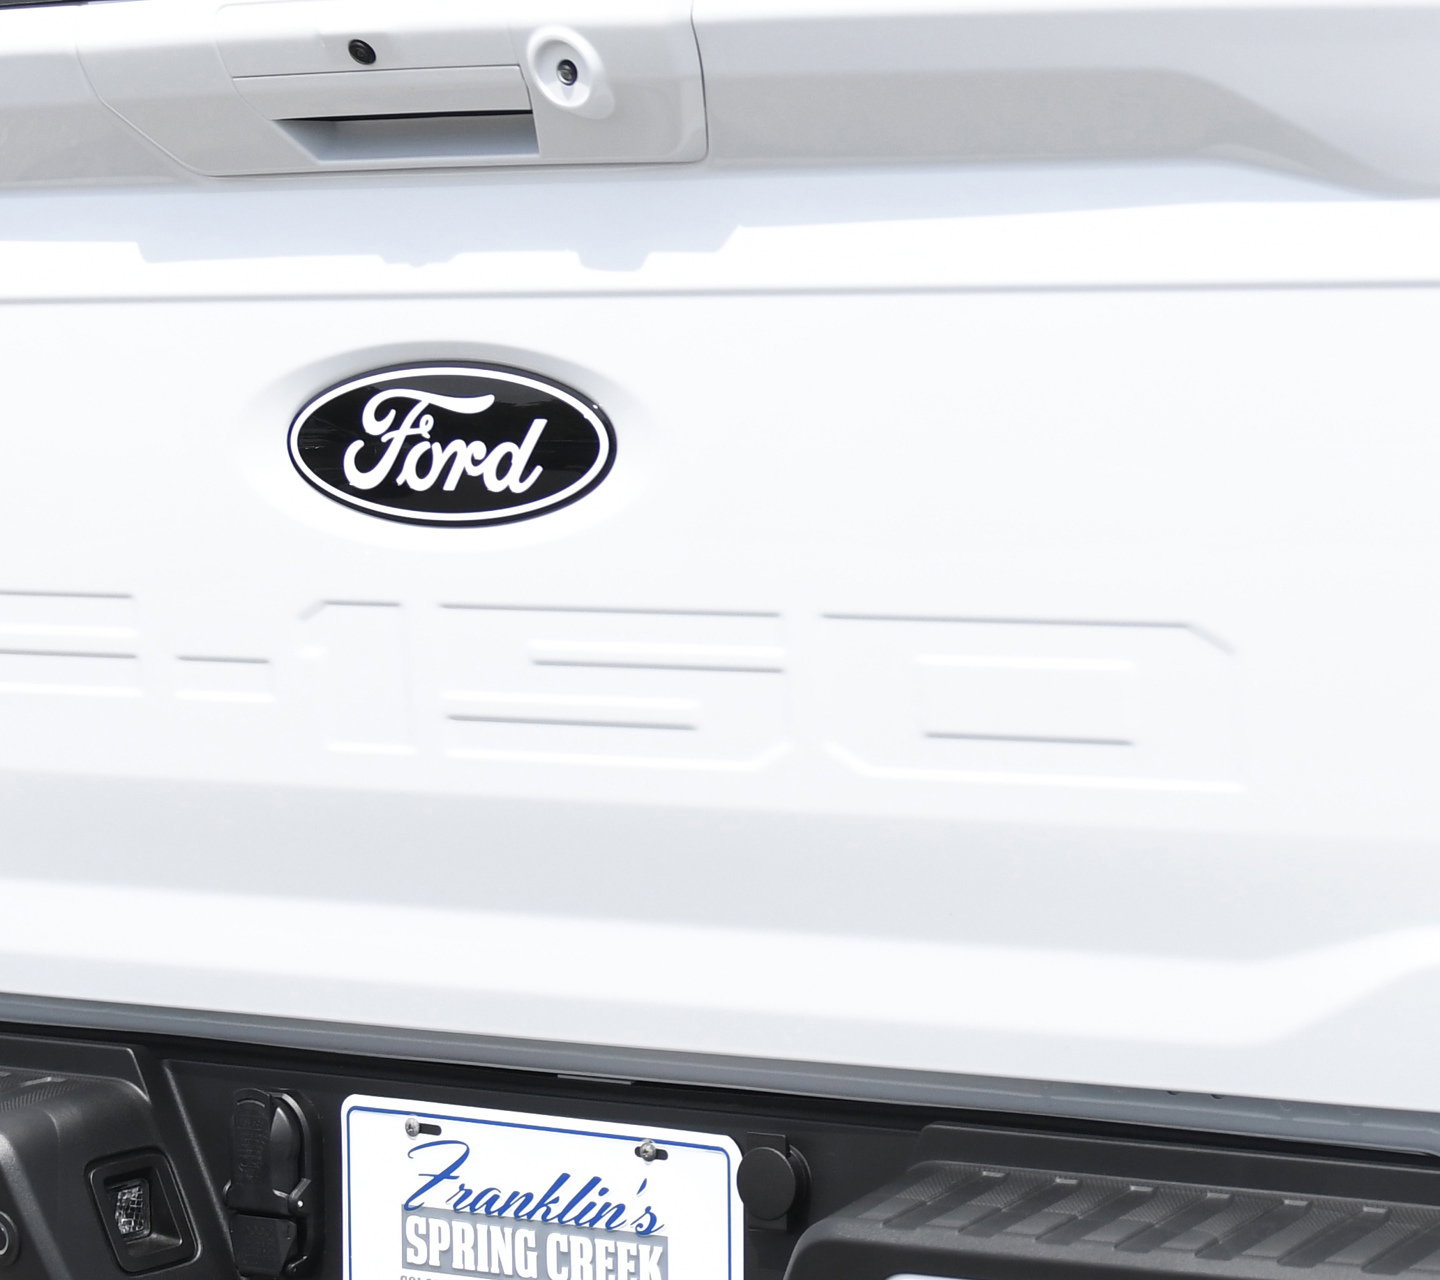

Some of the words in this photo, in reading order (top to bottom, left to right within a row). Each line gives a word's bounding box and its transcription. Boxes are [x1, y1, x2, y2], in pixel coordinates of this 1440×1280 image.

[343, 387, 548, 494] Ford
[403, 1139, 665, 1236] Franklin's
[406, 1215, 538, 1279] SPRING
